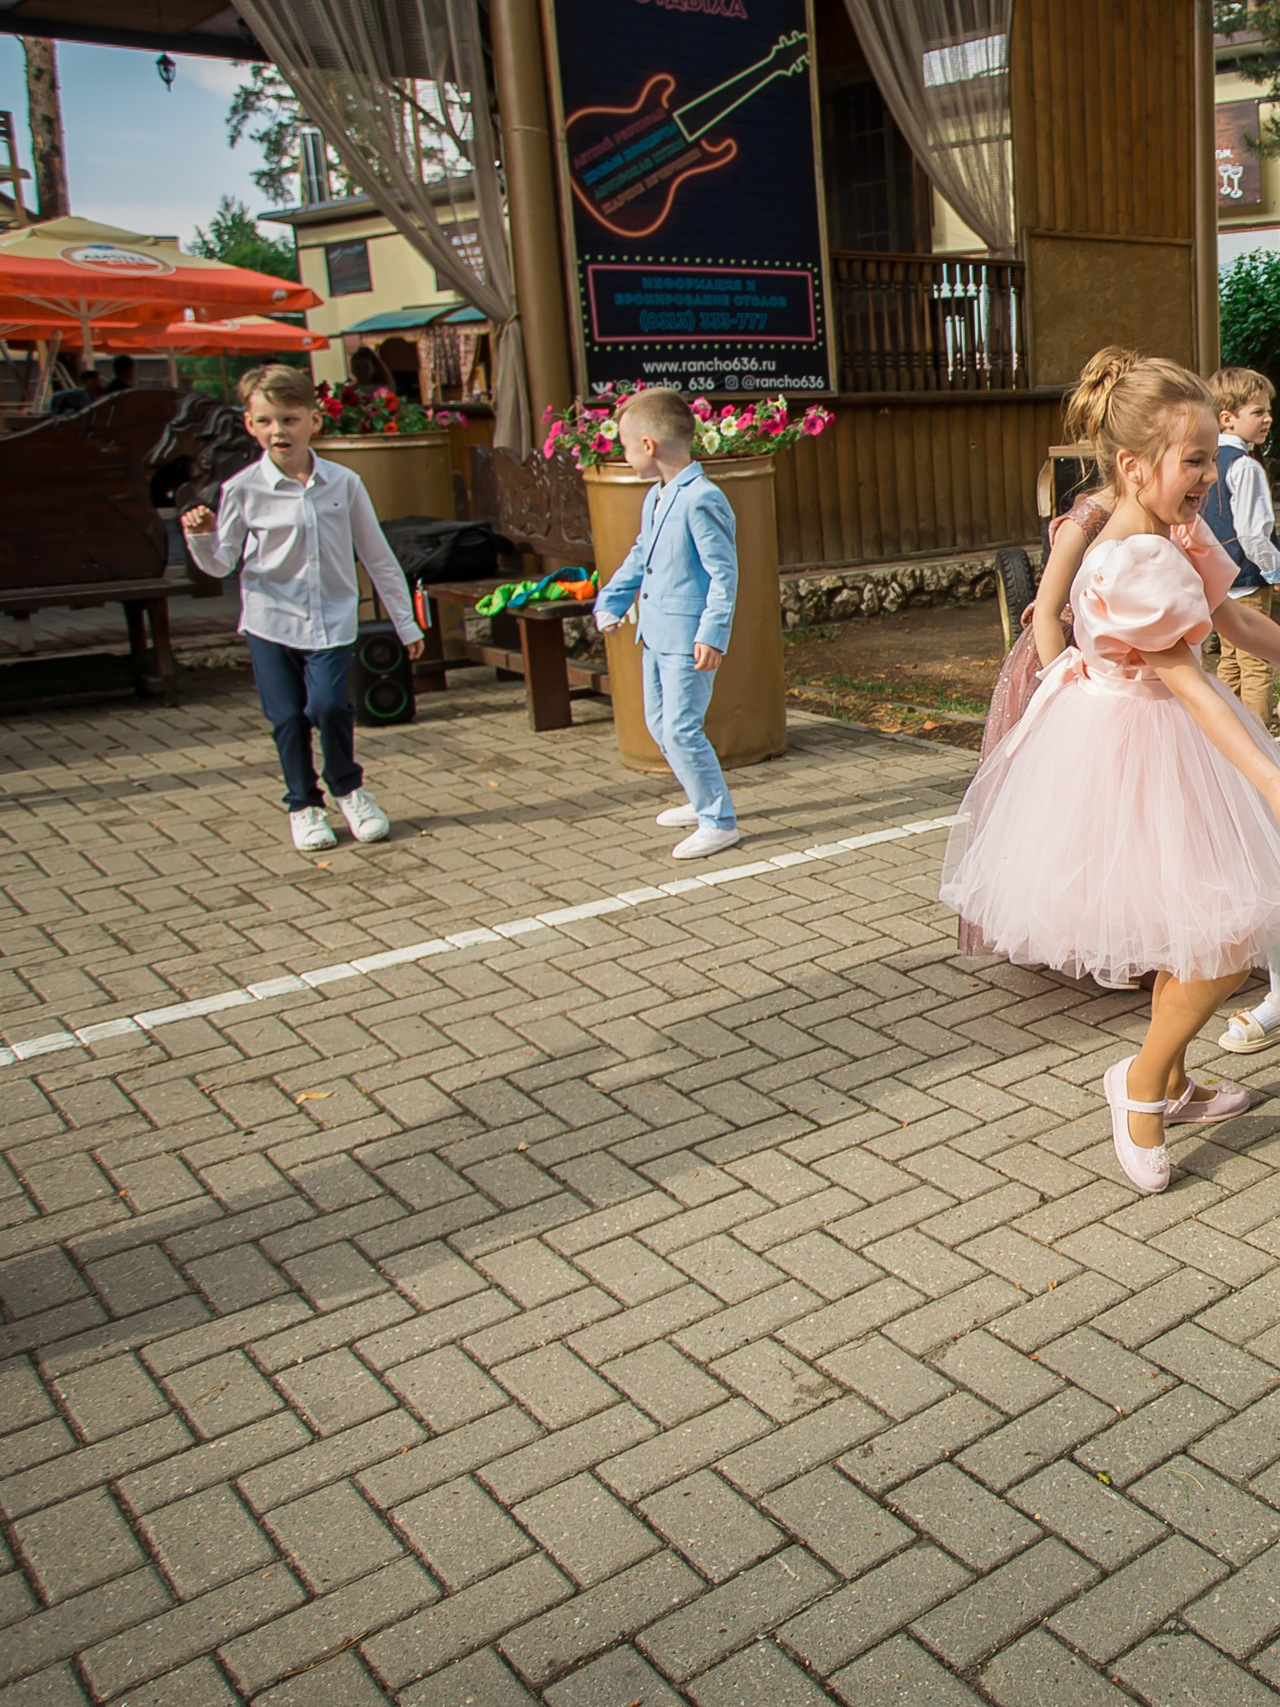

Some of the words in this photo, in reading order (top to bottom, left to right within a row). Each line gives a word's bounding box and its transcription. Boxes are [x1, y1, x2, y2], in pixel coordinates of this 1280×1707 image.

[634, 0, 748, 19] ДЫХА
[745, 279, 757, 292] И
[614, 292, 730, 307] БРОНИРОВАНИЕ
[733, 295, 788, 308] СТОЛОВ
[642, 356, 777, 374] www.rancho636.ru
[742, 374, 825, 390] @rancho636
